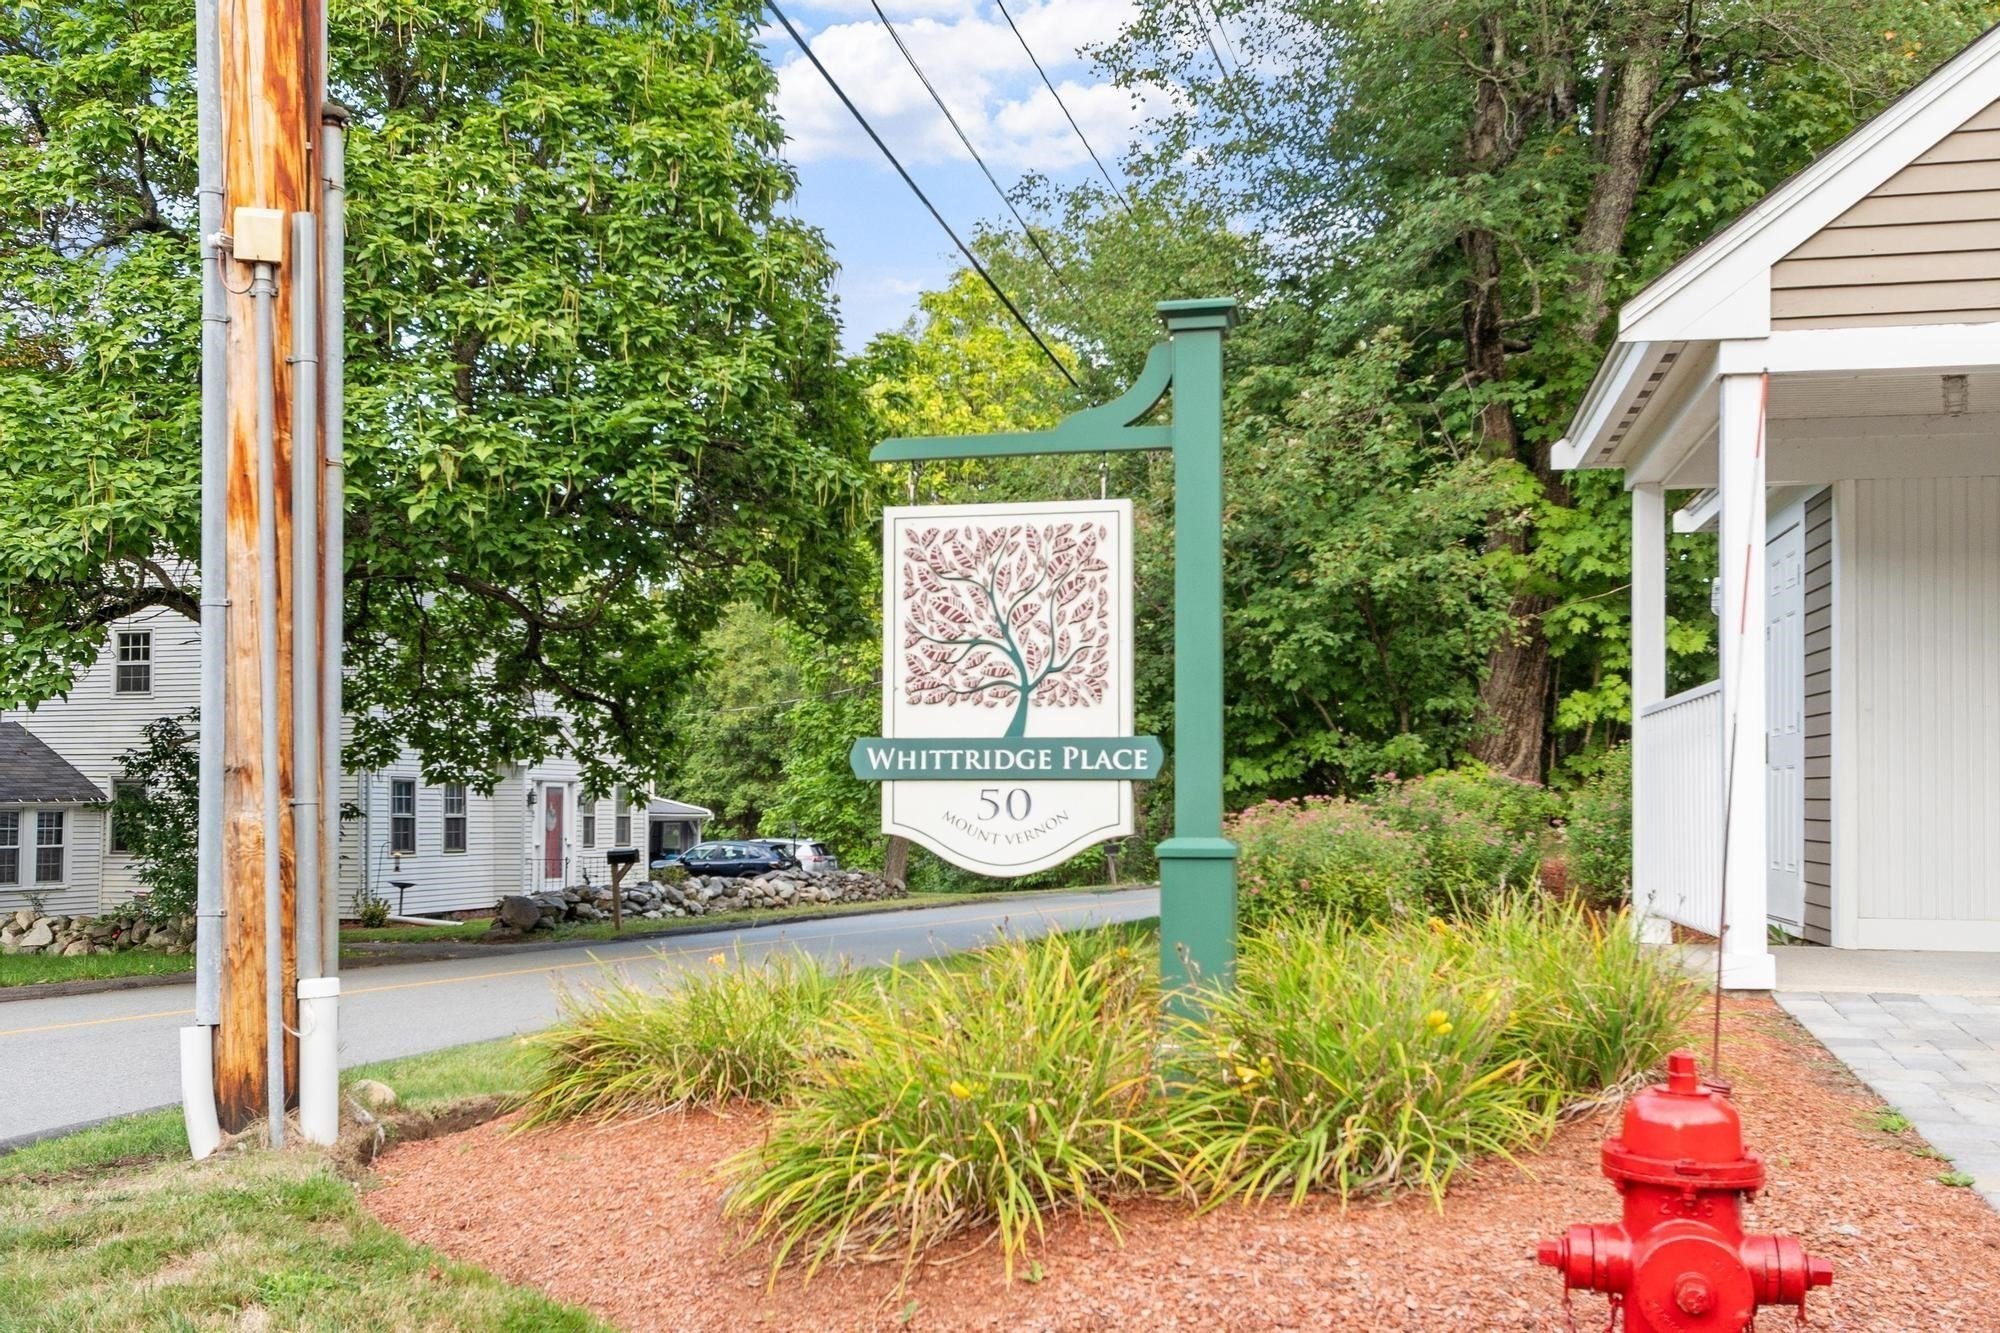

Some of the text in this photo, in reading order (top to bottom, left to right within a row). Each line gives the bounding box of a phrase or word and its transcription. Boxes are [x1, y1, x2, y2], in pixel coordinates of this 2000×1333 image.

[866, 746, 1148, 771] WHITTRIDGE PLACE
[977, 788, 1032, 821] 50
[942, 810, 1069, 845] MOUNT VERNON
